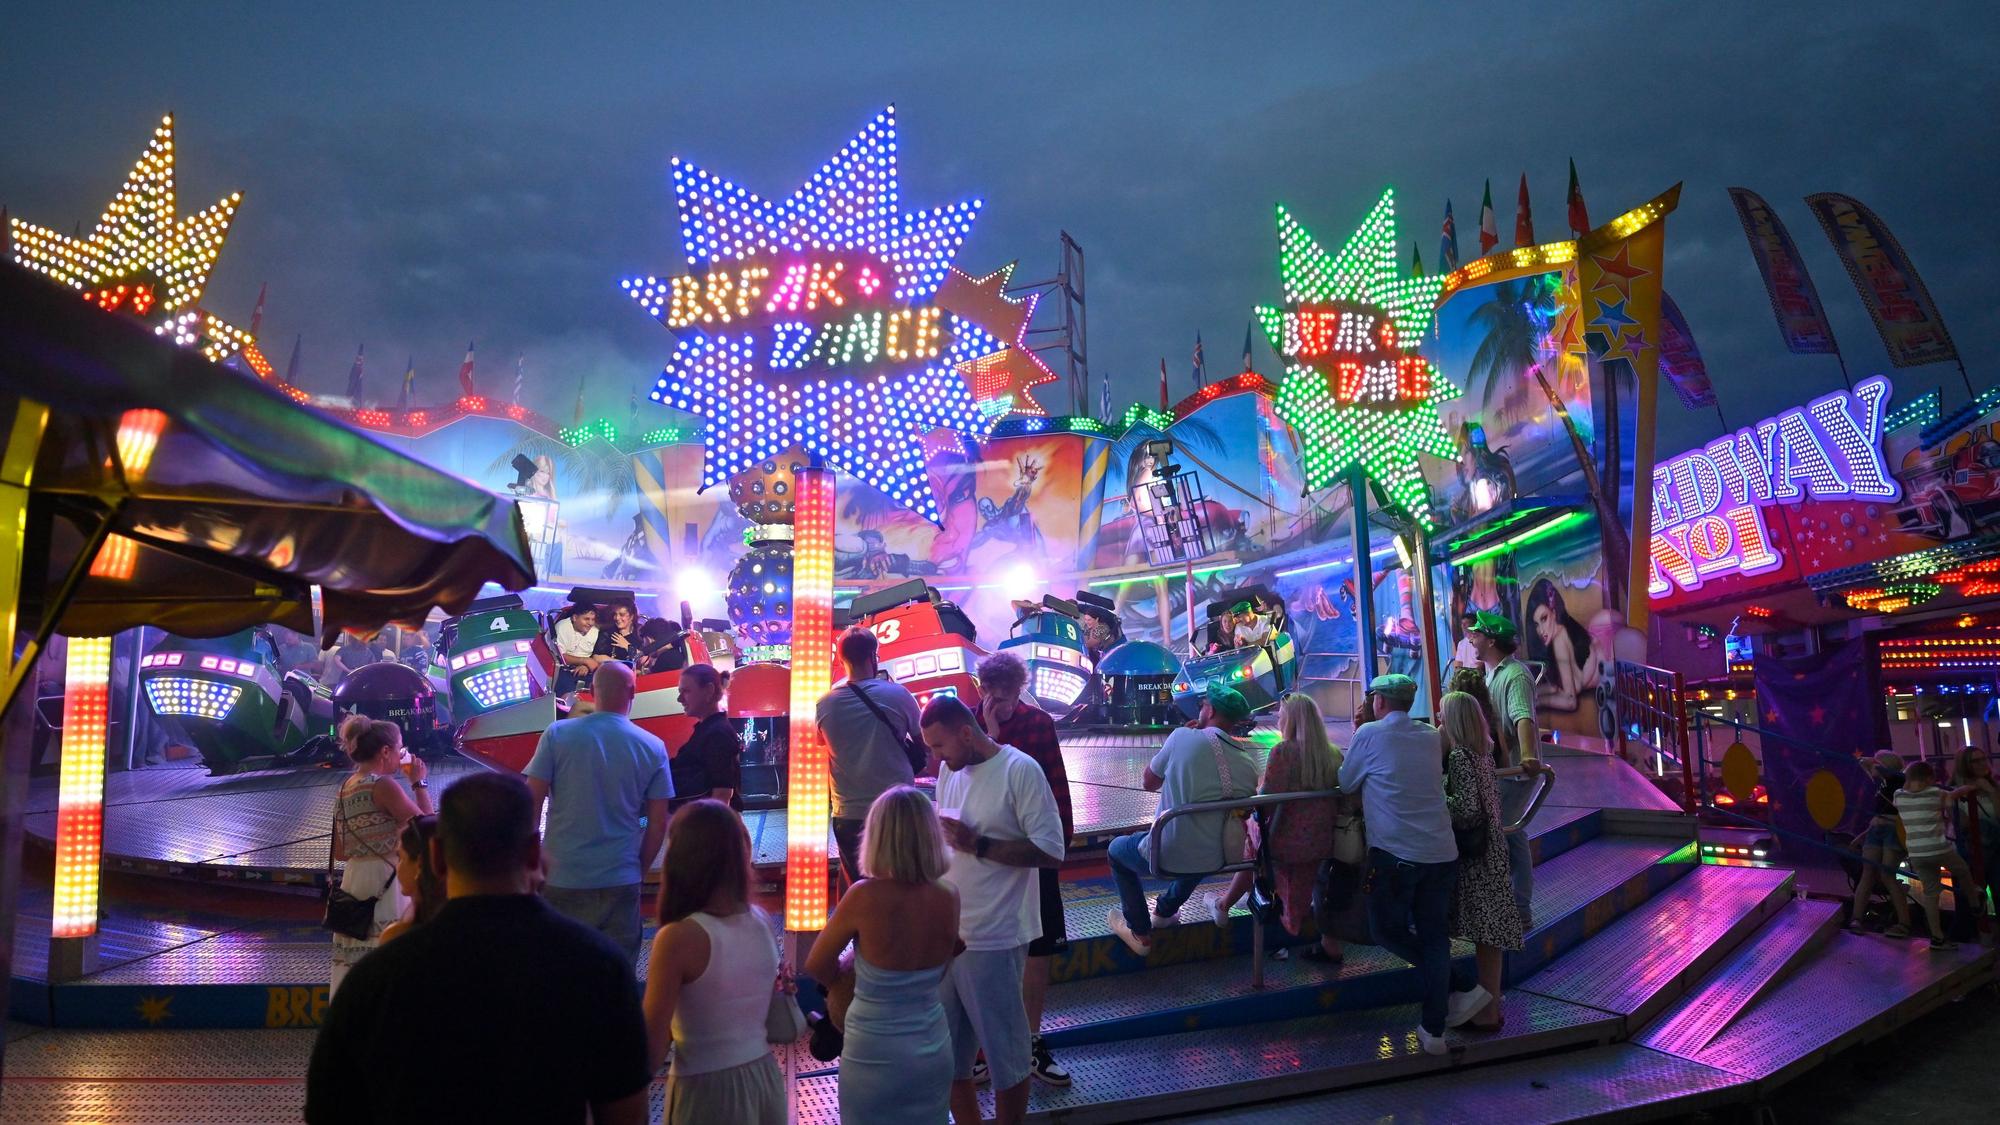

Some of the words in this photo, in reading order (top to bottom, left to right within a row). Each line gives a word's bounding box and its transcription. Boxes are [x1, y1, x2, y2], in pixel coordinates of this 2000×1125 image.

[667, 261, 846, 329] BREAK
[769, 305, 941, 368] DANCE
[1282, 311, 1377, 356] BREAK
[1650, 380, 1896, 534] EDWAY
[490, 616, 510, 631] 4
[1138, 683, 1162, 691] BREAK
[388, 708, 415, 717] BREAK
[265, 986, 330, 1027] BRE
